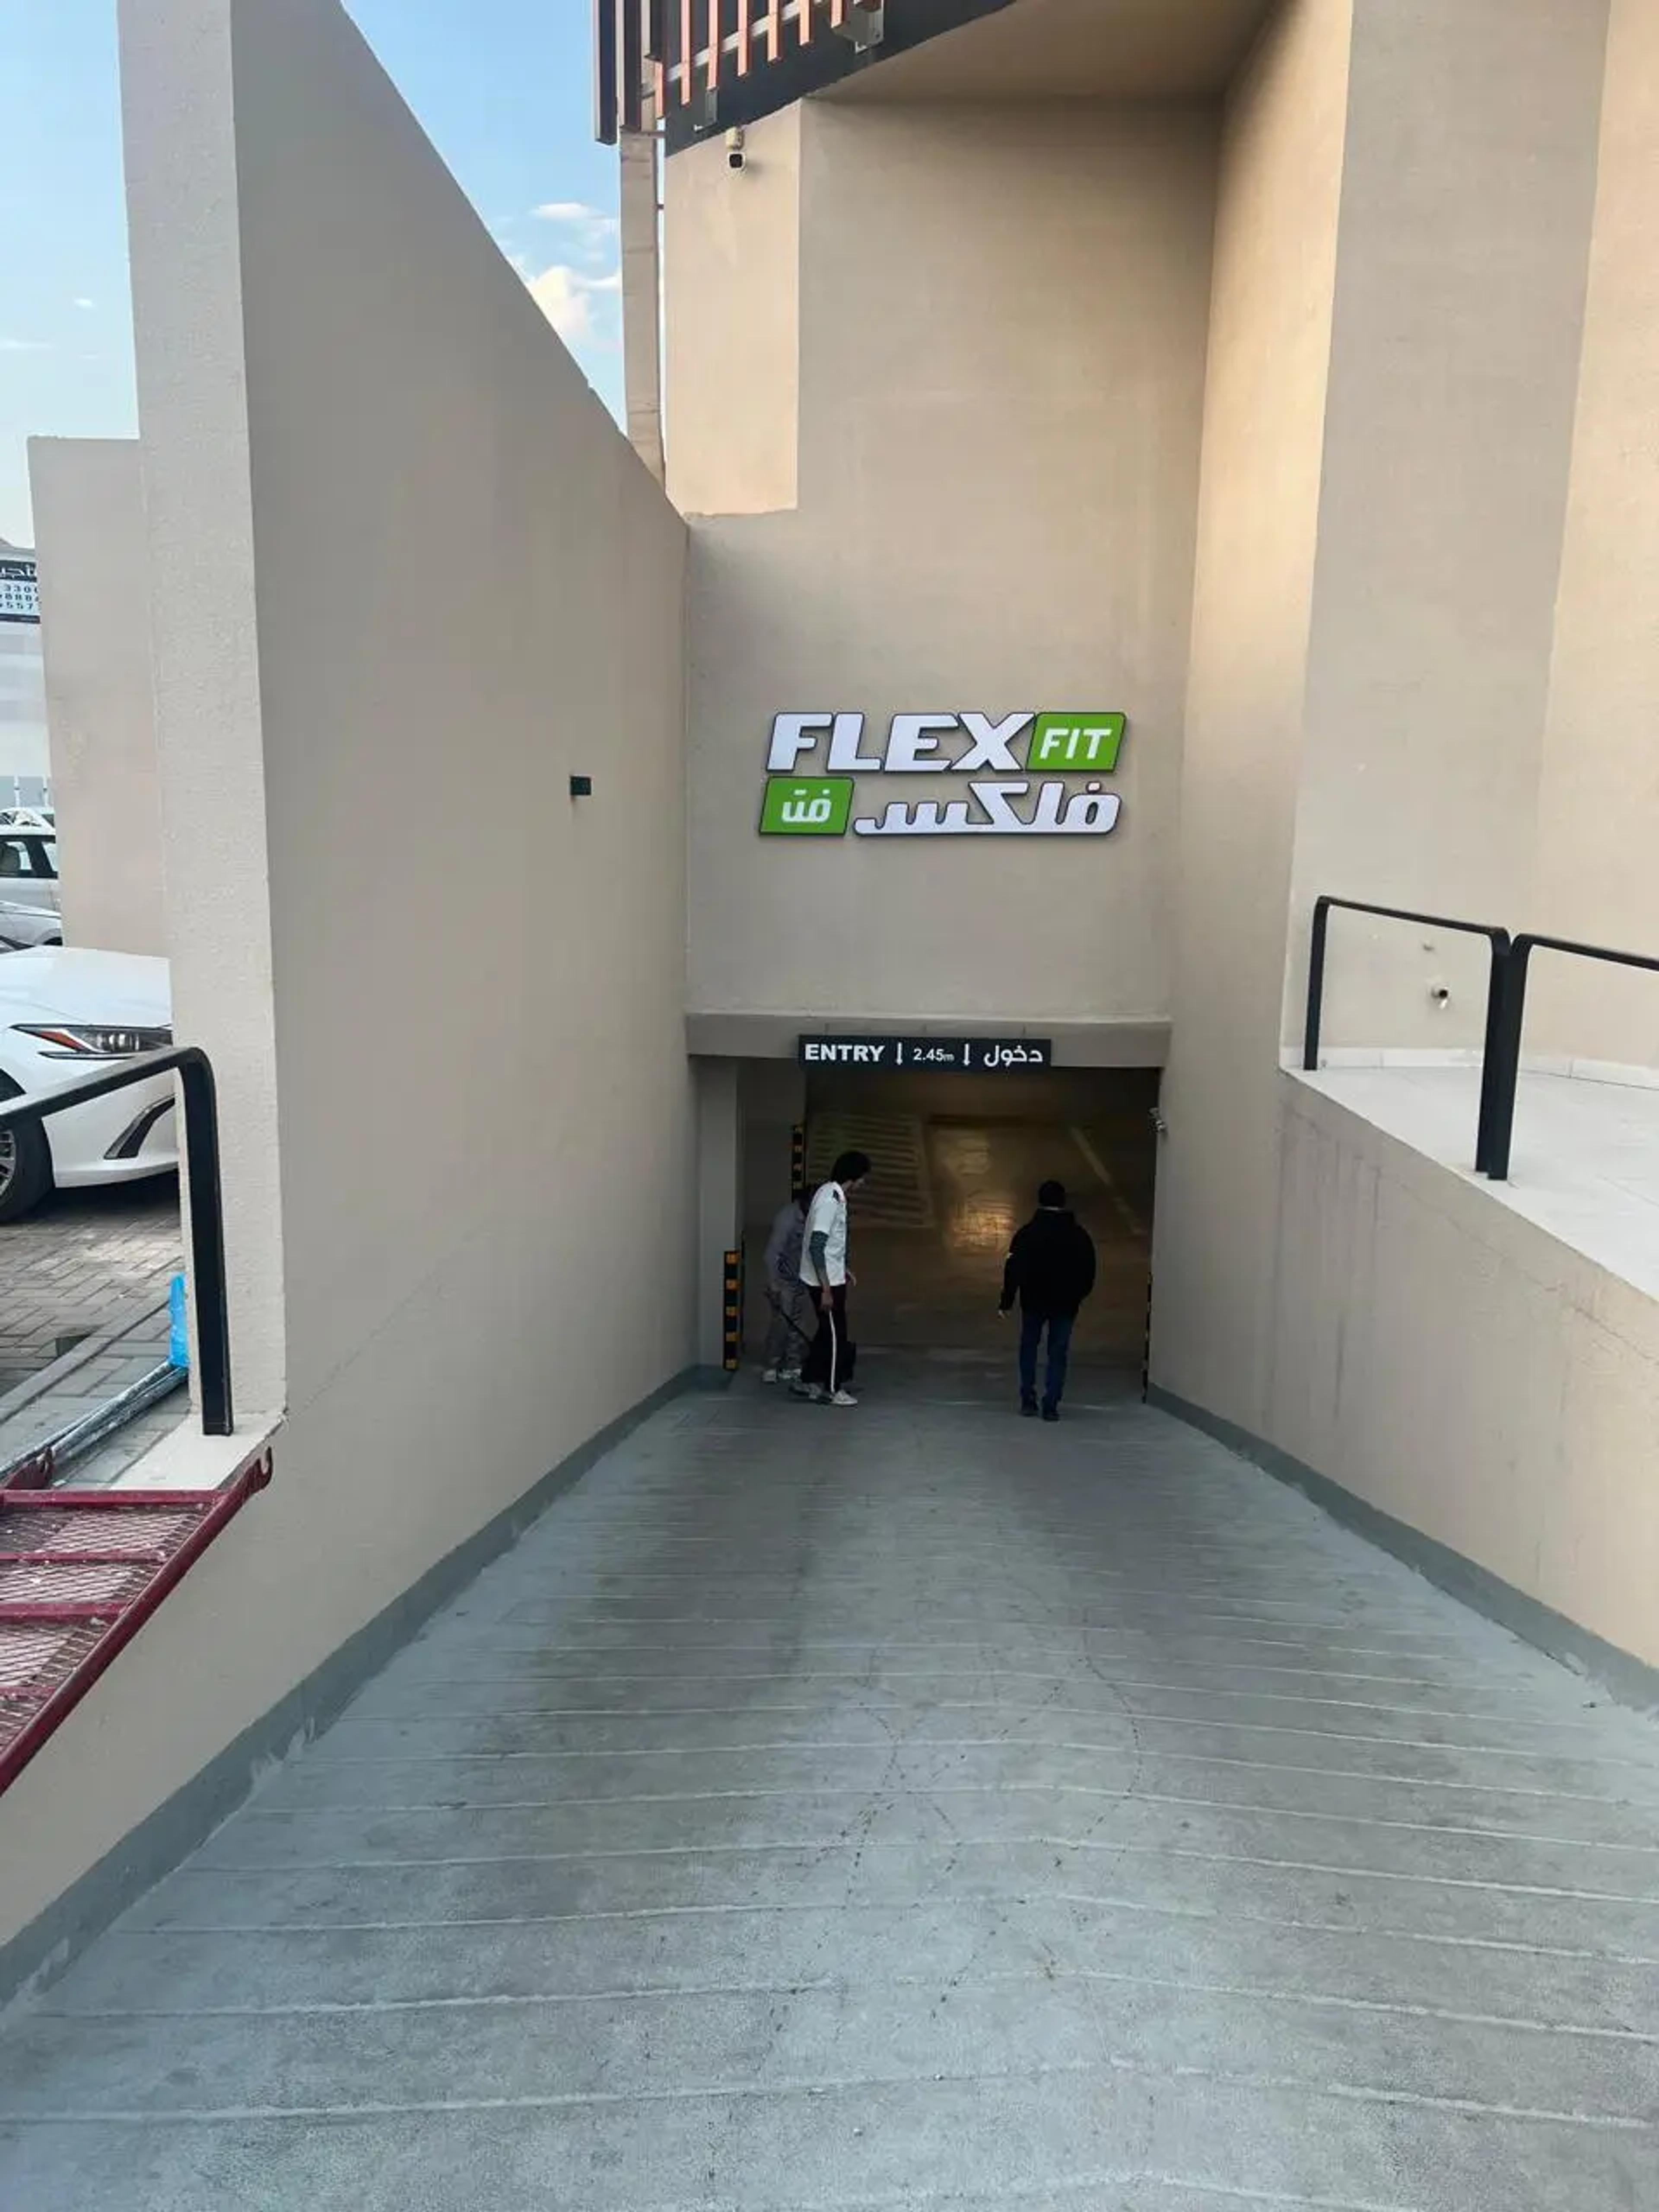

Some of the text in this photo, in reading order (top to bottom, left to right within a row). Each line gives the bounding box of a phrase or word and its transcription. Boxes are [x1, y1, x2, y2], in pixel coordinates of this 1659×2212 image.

[766, 713, 1113, 771] FLEX FIT
[854, 781, 1122, 834] فلكس
[804, 1043, 885, 1062] ENTRY
[913, 1048, 955, 1062] 2.45m
[983, 1045, 1043, 1067] دخول
